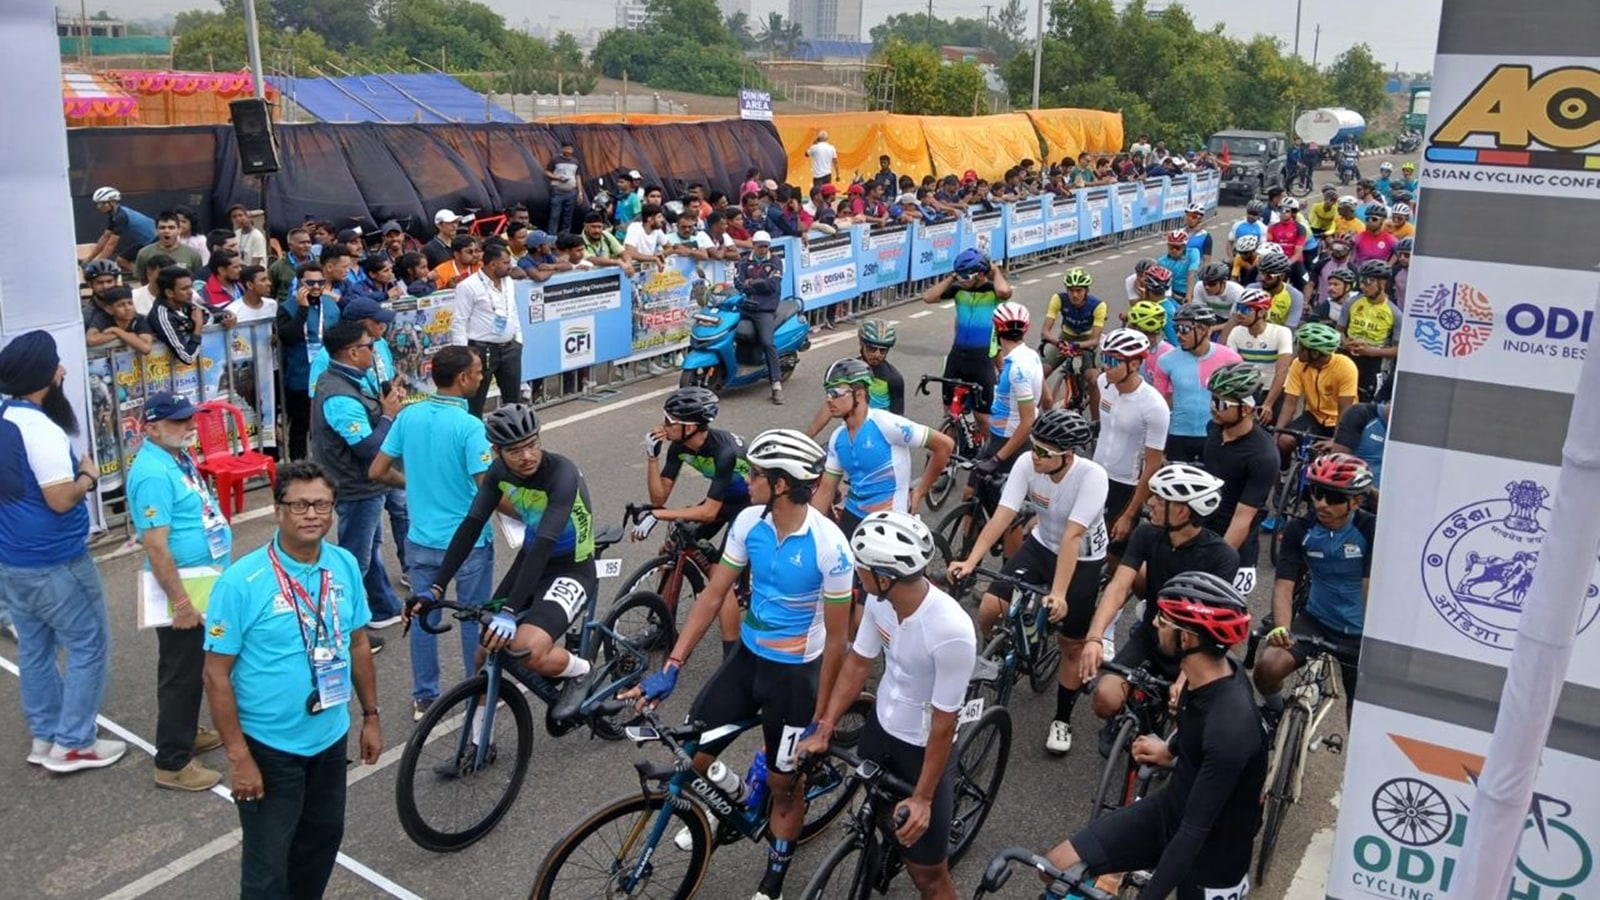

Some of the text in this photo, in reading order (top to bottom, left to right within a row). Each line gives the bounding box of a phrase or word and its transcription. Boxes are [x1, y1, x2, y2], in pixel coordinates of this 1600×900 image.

[742, 90, 770, 101] DINING
[746, 100, 770, 110] AREA
[1422, 168, 1470, 180] ASIAN
[1473, 171, 1544, 185] CYCLING
[801, 283, 813, 294] CFI
[1505, 303, 1594, 343] ODI
[565, 333, 591, 354] CFI
[1503, 340, 1558, 357] INDIA'S
[605, 561, 618, 574] 195
[551, 580, 579, 606] 195
[966, 703, 980, 719] 461
